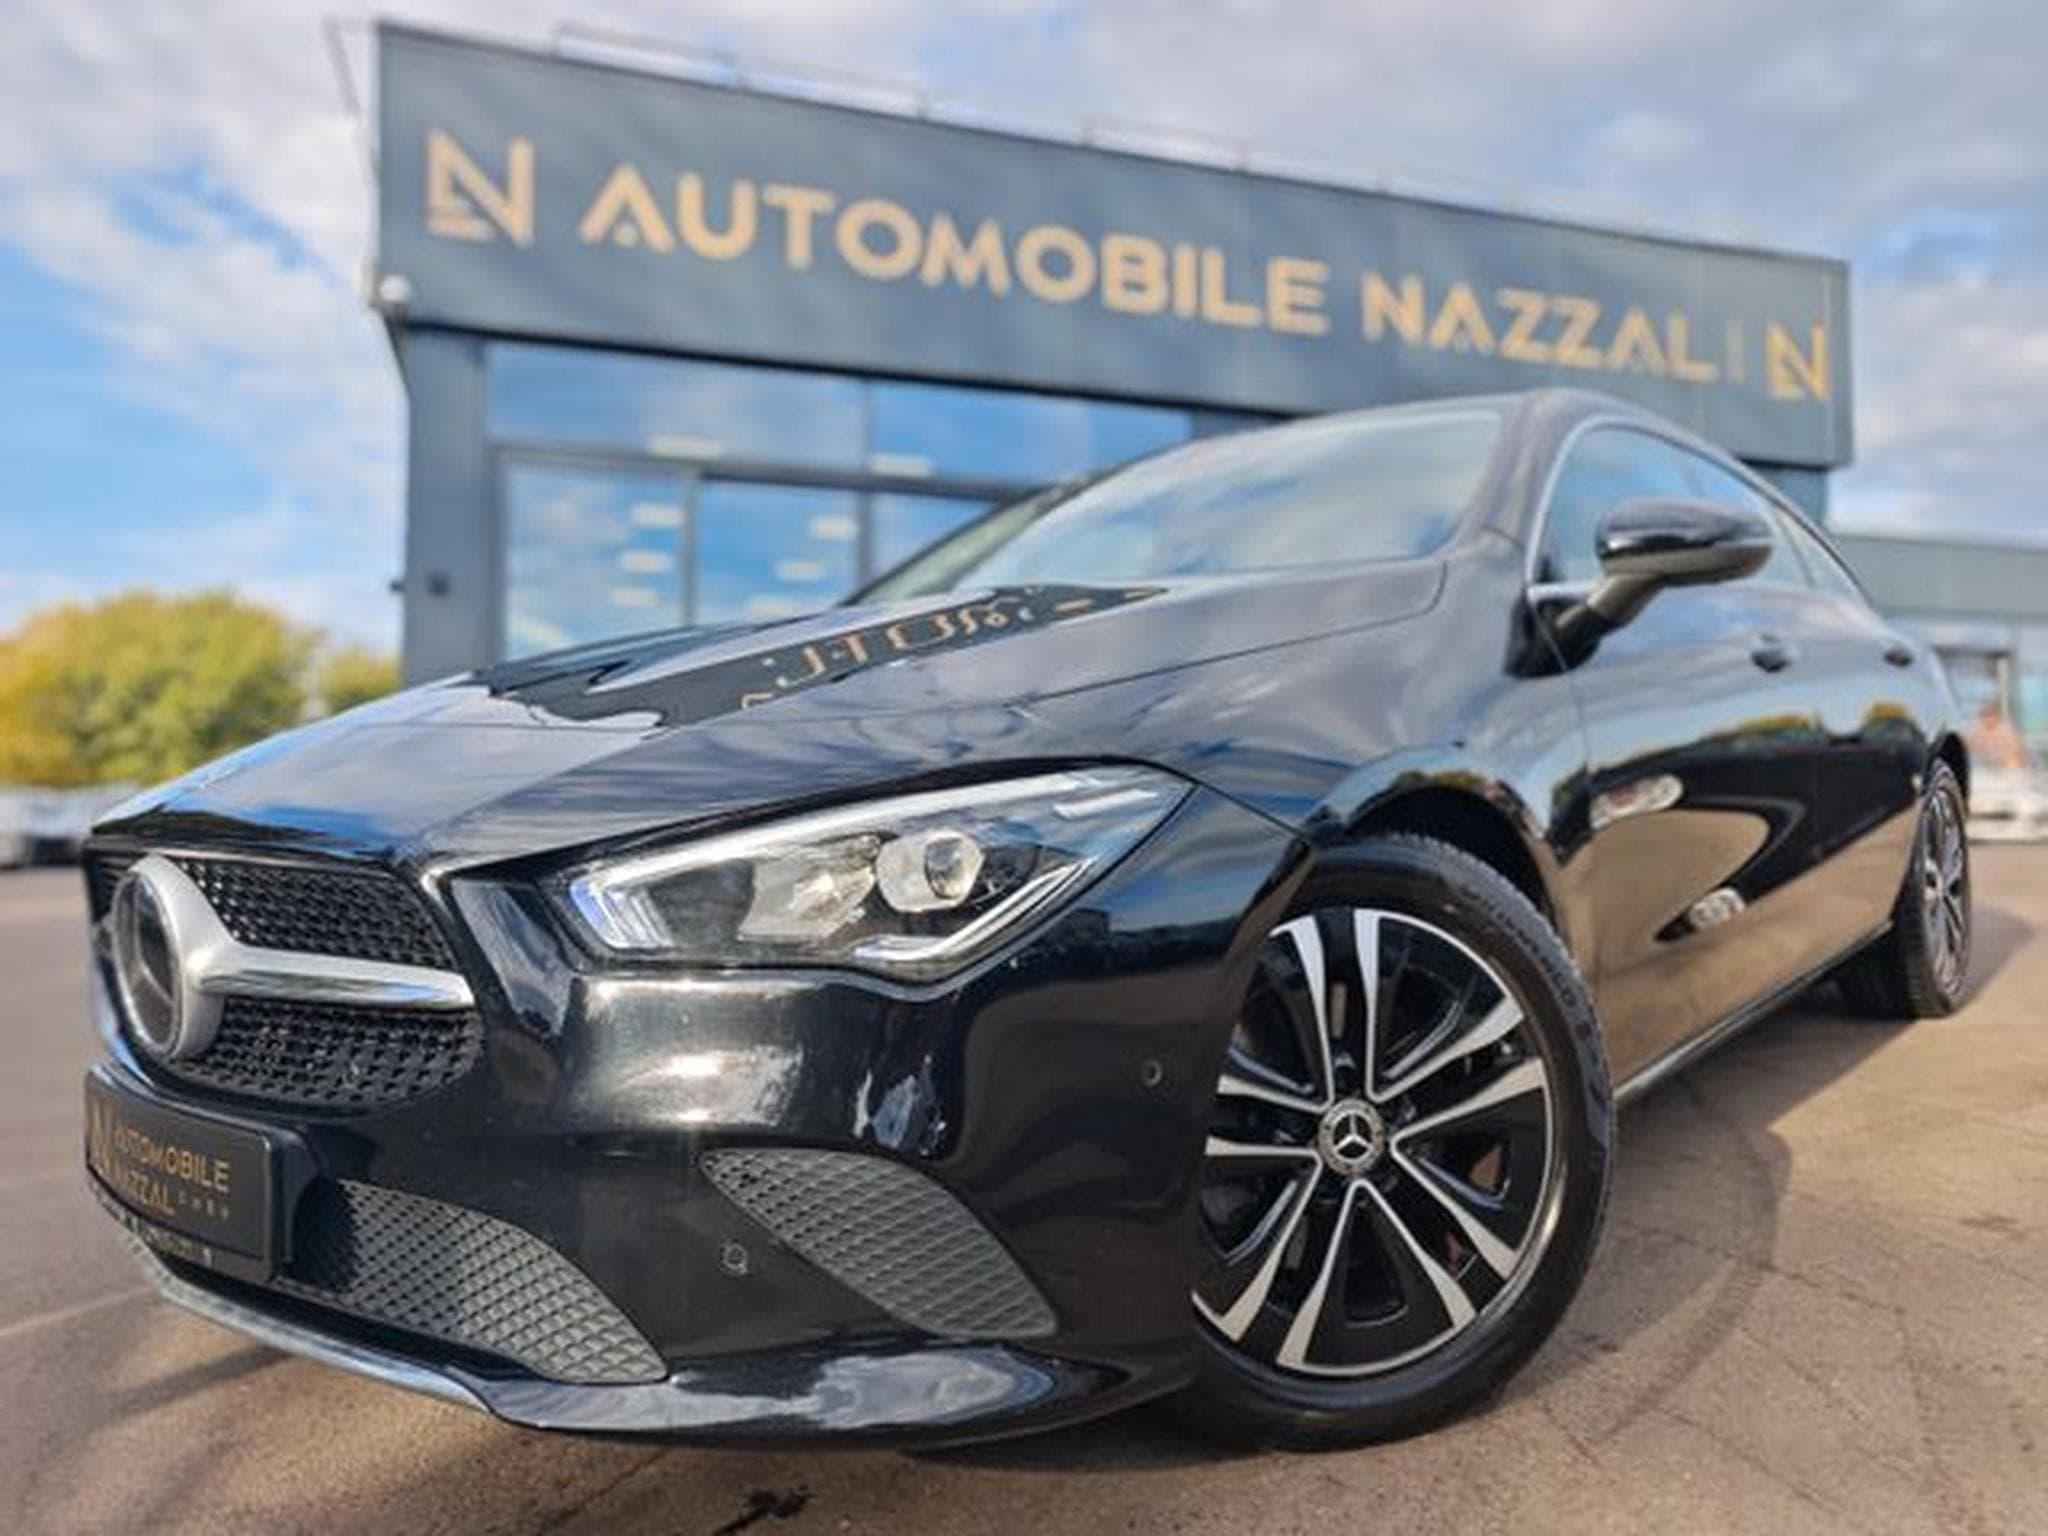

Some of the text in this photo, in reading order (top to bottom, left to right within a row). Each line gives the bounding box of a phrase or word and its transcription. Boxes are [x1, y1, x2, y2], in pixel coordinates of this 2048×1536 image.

[579, 166, 1328, 334] AUTOMOBILE
[1362, 274, 1717, 382] NAZZAL
[115, 1125, 231, 1193] TOMOBILE
